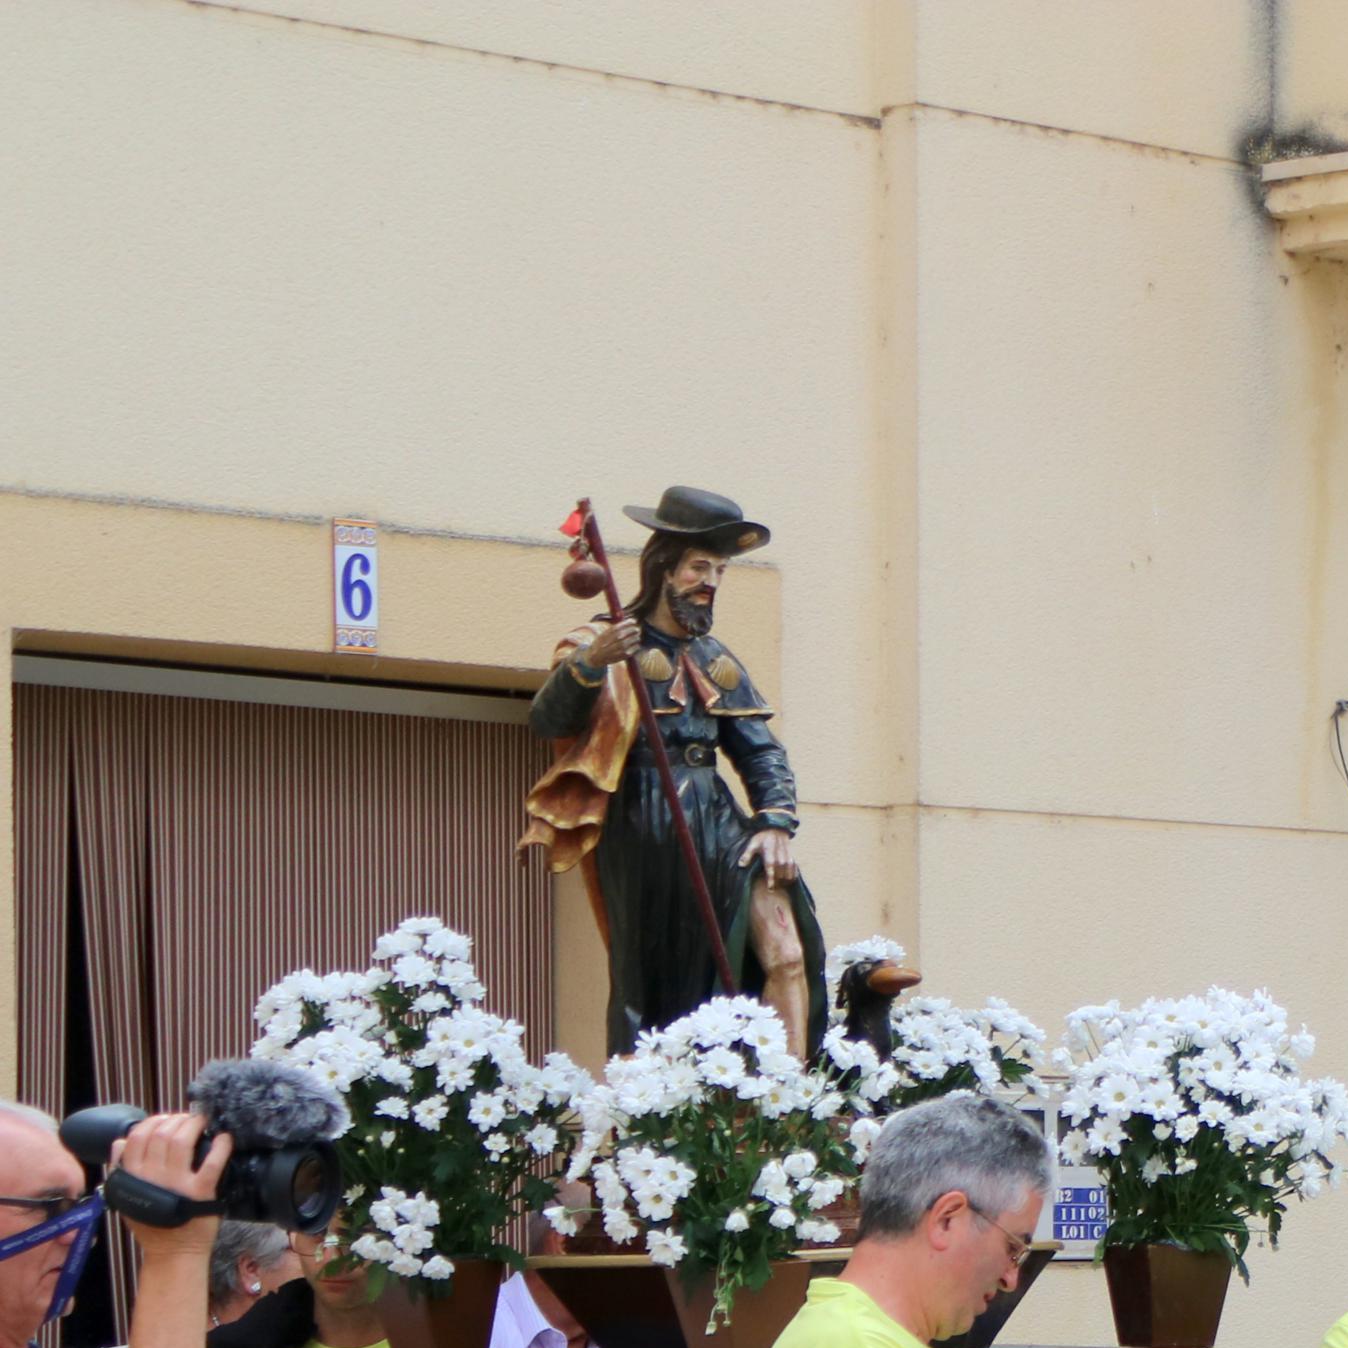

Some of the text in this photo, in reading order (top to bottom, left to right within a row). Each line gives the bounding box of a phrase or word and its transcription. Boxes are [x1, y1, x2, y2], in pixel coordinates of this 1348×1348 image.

[340, 552, 373, 622] 6
[1088, 1190, 1105, 1203] 01
[1061, 1225, 1085, 1239] L01
